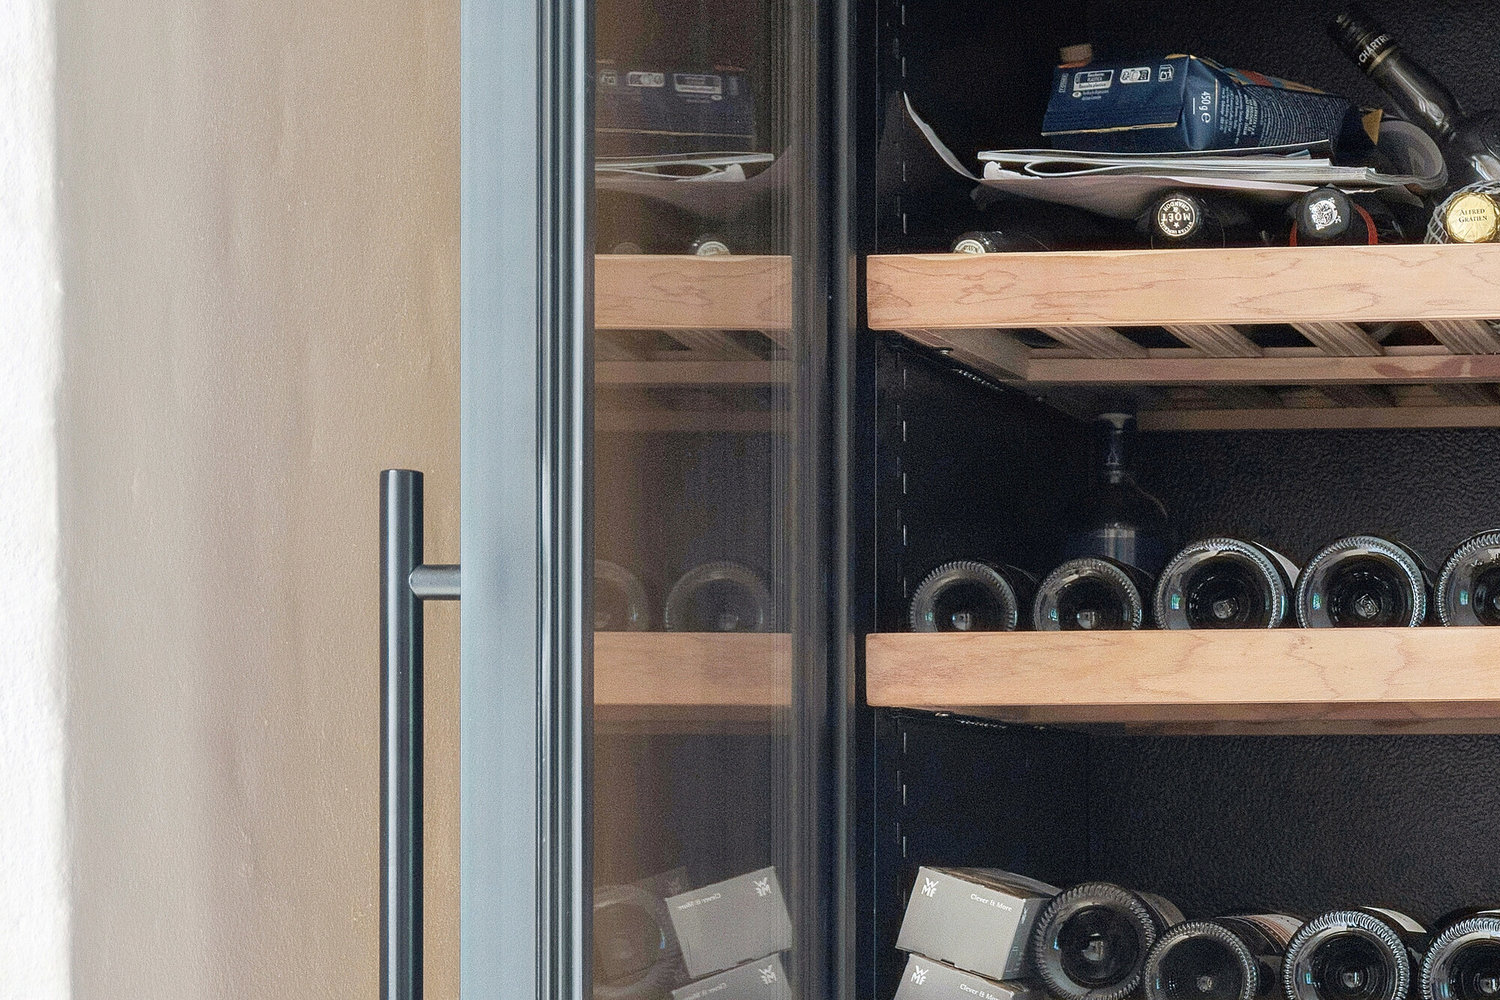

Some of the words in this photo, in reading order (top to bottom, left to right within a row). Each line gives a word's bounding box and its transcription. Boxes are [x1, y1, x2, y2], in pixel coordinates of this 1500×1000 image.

[1201, 91, 1211, 105] 450
[1460, 208, 1485, 216] ALFRED
[1458, 215, 1488, 223] GRATIEN
[970, 893, 989, 904] Clever
[997, 901, 1013, 912] More
[959, 983, 979, 996] Clever
